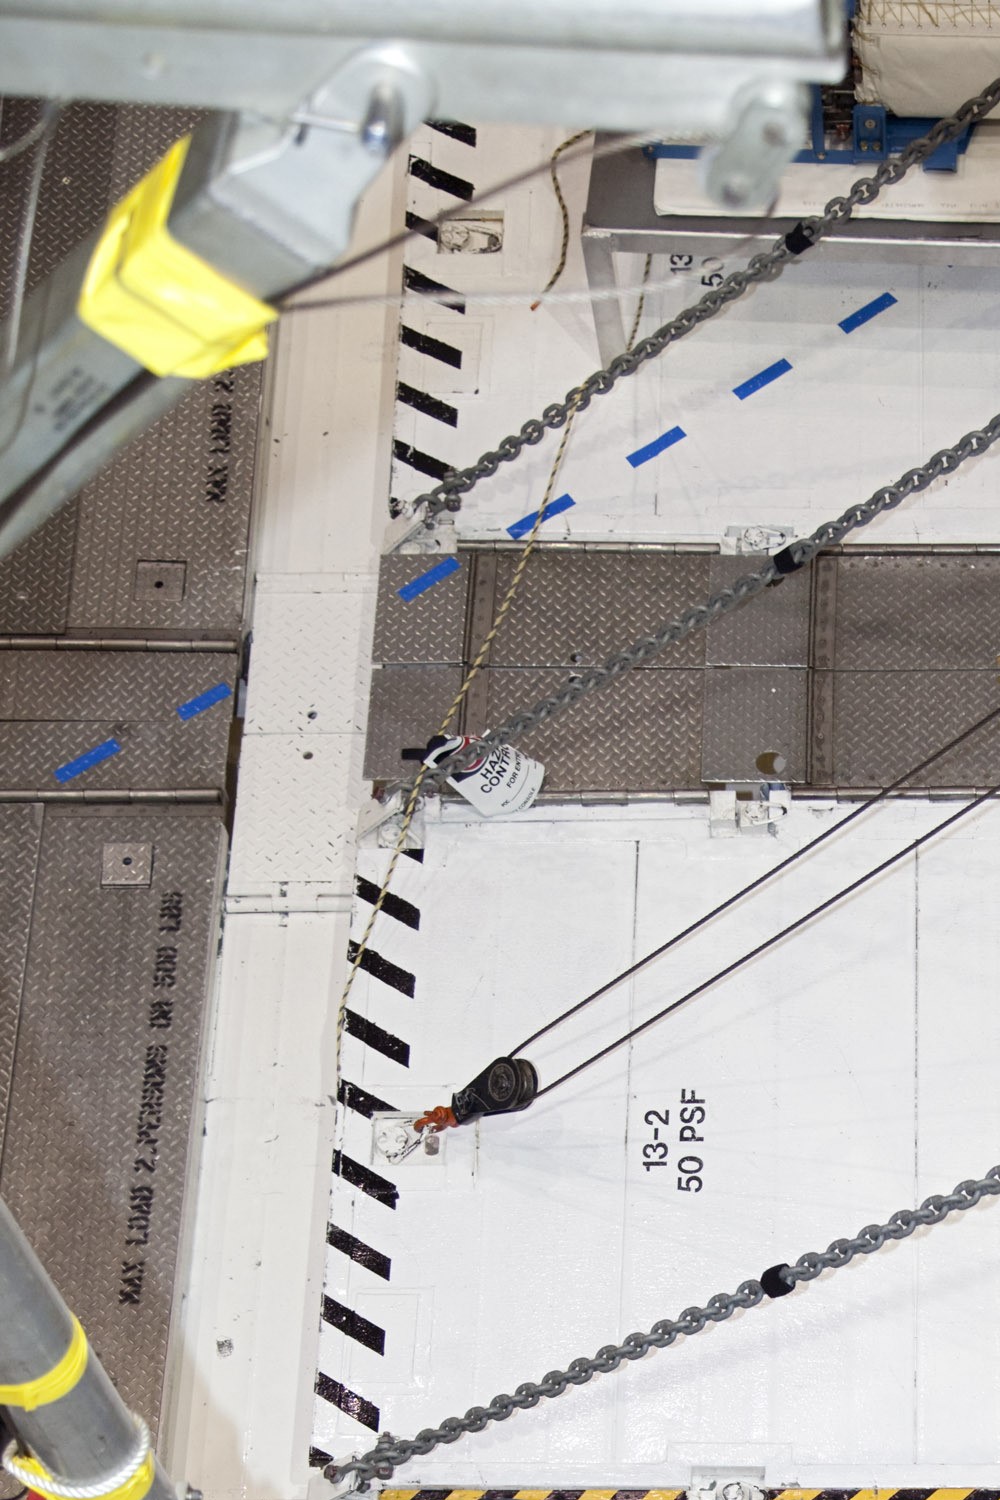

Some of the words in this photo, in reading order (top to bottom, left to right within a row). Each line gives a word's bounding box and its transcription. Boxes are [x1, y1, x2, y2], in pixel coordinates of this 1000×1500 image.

[205, 465, 228, 503] MAX
[506, 771, 519, 789] FOR
[159, 890, 184, 933] LBS
[679, 1088, 706, 1142] PSF
[642, 1109, 670, 1172] 13-2
[677, 1155, 704, 1193] 50
[124, 1185, 155, 1246] LOAD
[119, 1260, 145, 1307] MAX
